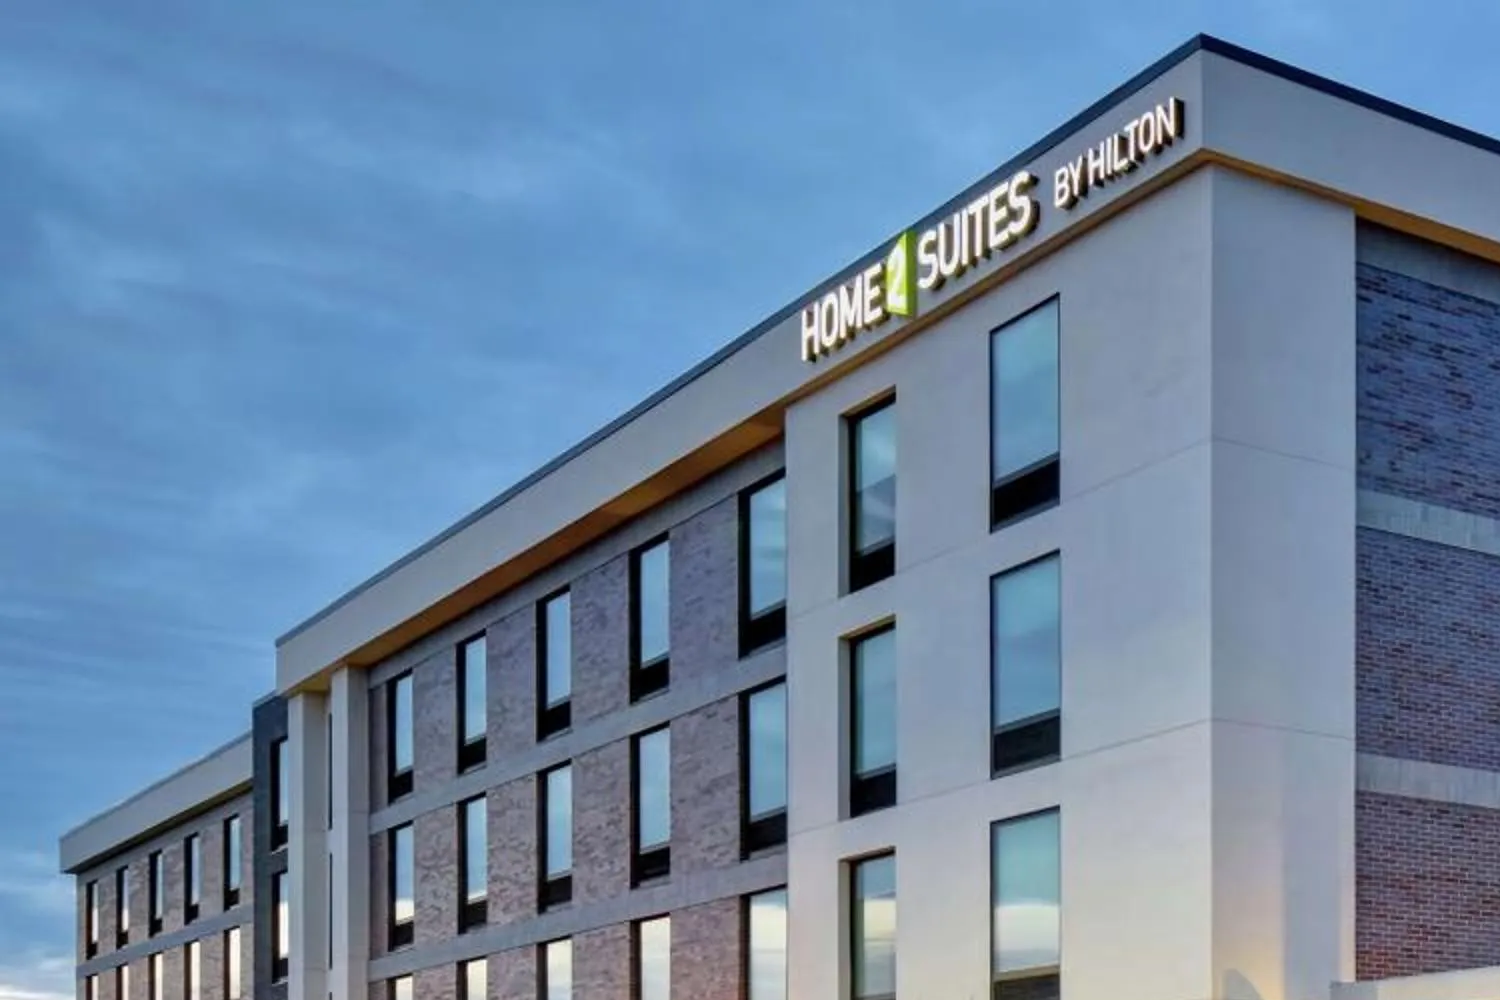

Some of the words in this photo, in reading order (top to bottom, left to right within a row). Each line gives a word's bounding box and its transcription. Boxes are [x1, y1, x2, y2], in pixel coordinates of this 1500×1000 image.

[801, 263, 885, 361] HOME
[917, 171, 1033, 288] SUITES
[1054, 156, 1083, 208] BY
[1087, 97, 1176, 186] HILTON
